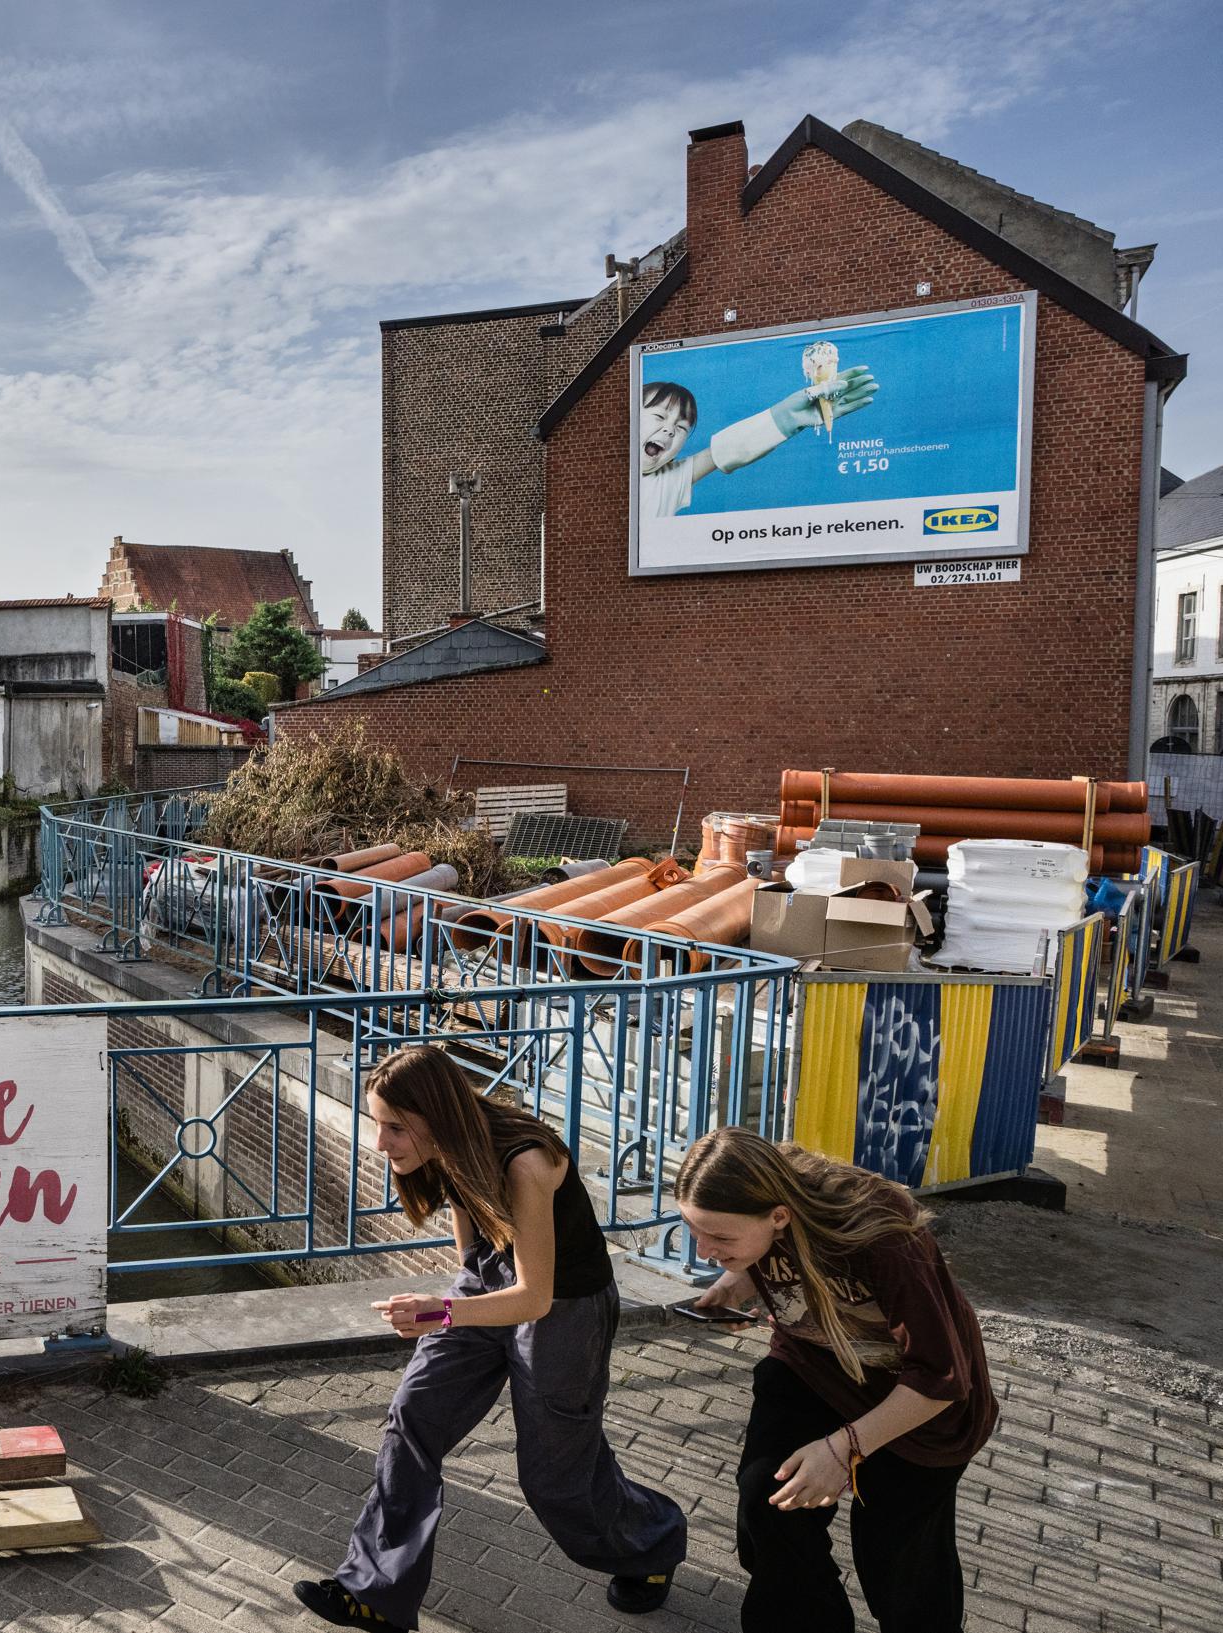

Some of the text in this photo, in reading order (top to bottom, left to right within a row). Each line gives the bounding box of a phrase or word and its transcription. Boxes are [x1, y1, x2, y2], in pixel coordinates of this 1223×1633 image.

[643, 342, 680, 352] JCDecaux
[838, 438, 884, 451] RINNIG
[883, 442, 950, 455] handschoenen
[838, 457, 890, 474] € 1,50
[930, 512, 993, 527] IKEA
[712, 516, 905, 544] Op ons kan je rekenen.
[916, 560, 1018, 574] UW BOODSCHAP HIER
[930, 572, 1002, 584] 02/274.11.01
[20, 1297, 77, 1314] TIENEN
